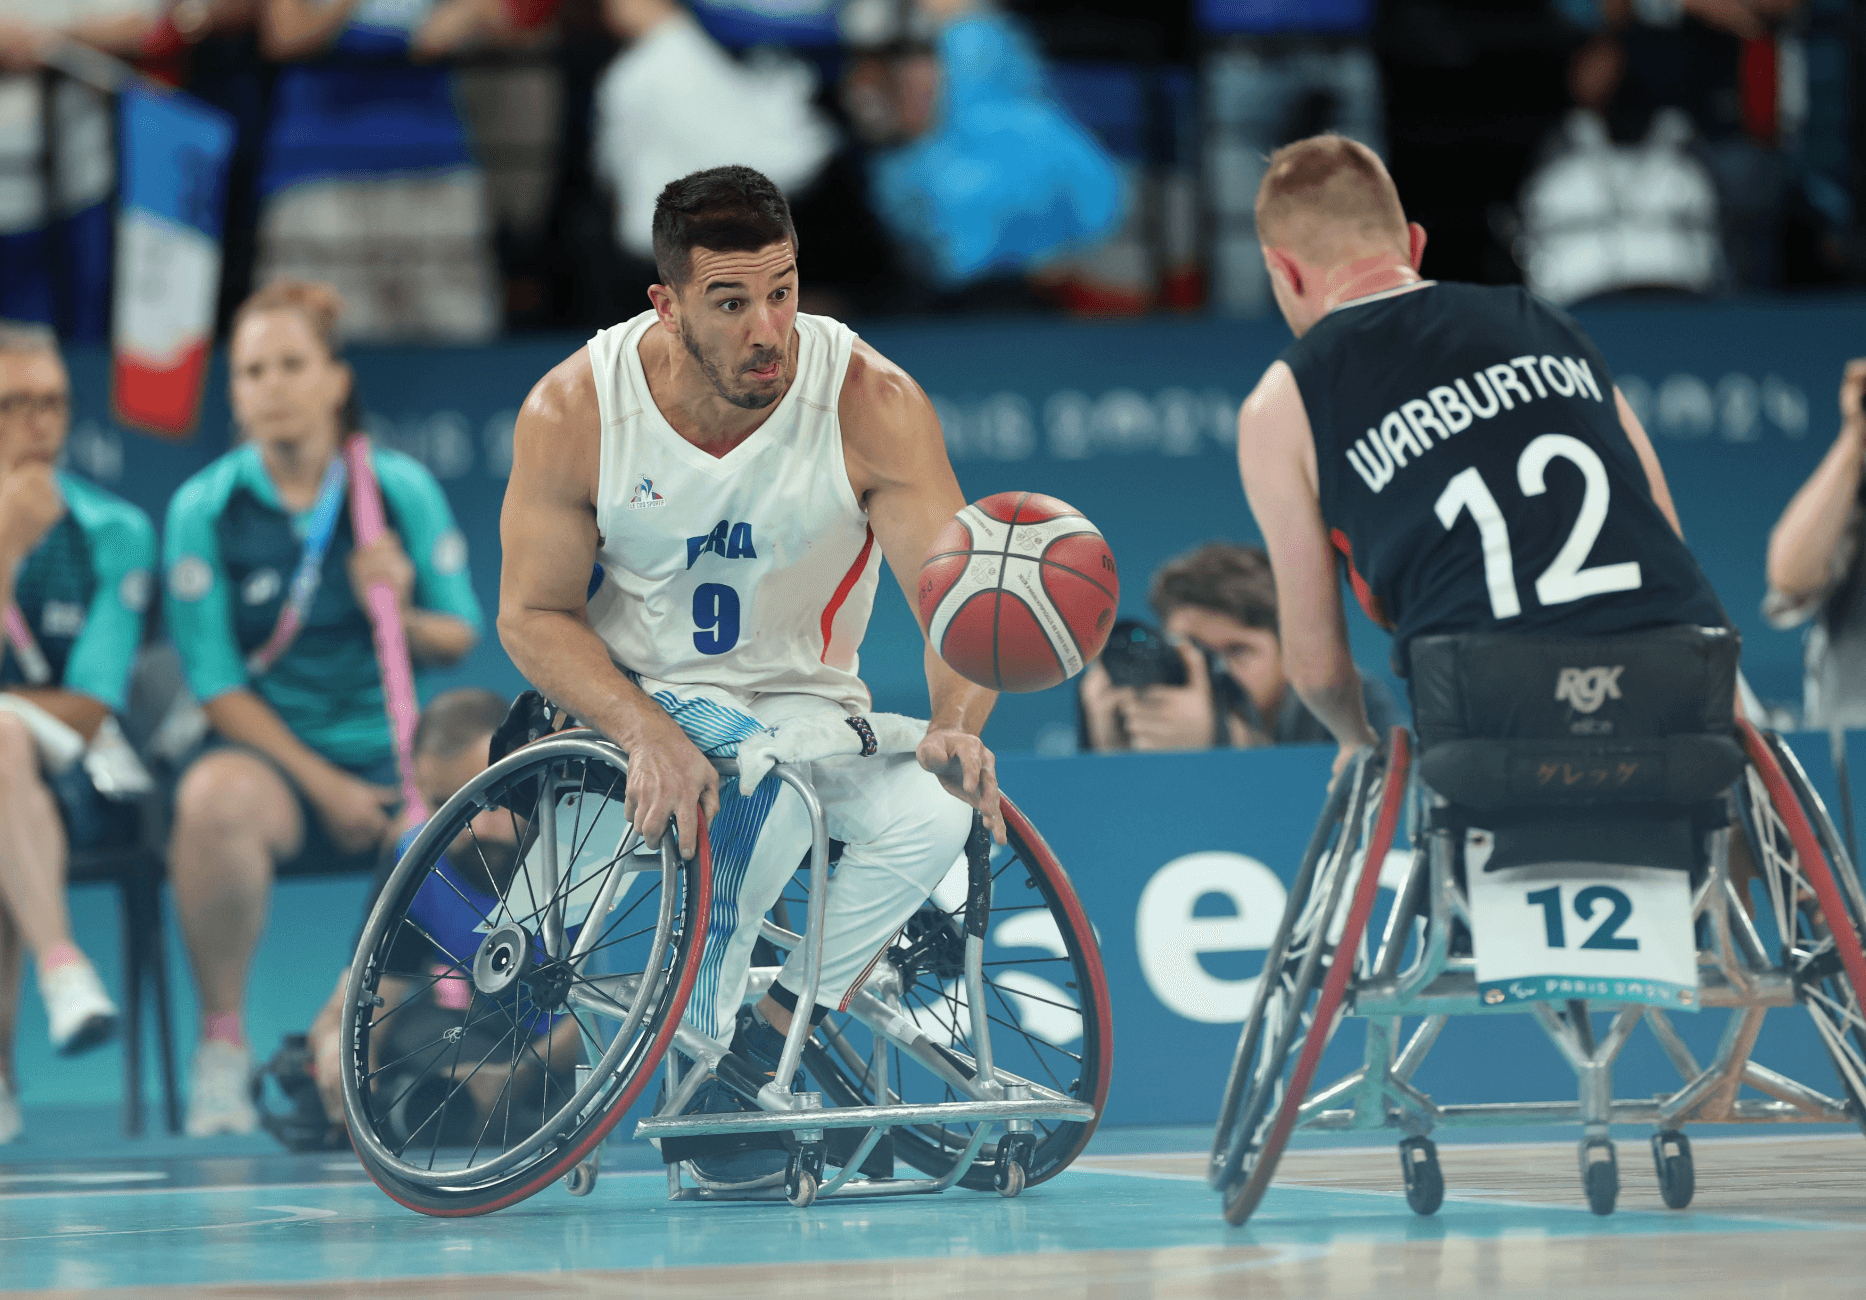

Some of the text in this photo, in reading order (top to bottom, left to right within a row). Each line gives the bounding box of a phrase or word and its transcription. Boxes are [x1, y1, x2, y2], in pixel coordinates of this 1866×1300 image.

[1346, 355, 1603, 494] WARBURTON
[686, 519, 758, 571] FRA
[1434, 433, 1643, 619] 12
[692, 582, 741, 656] 9
[1526, 886, 1640, 951] 12
